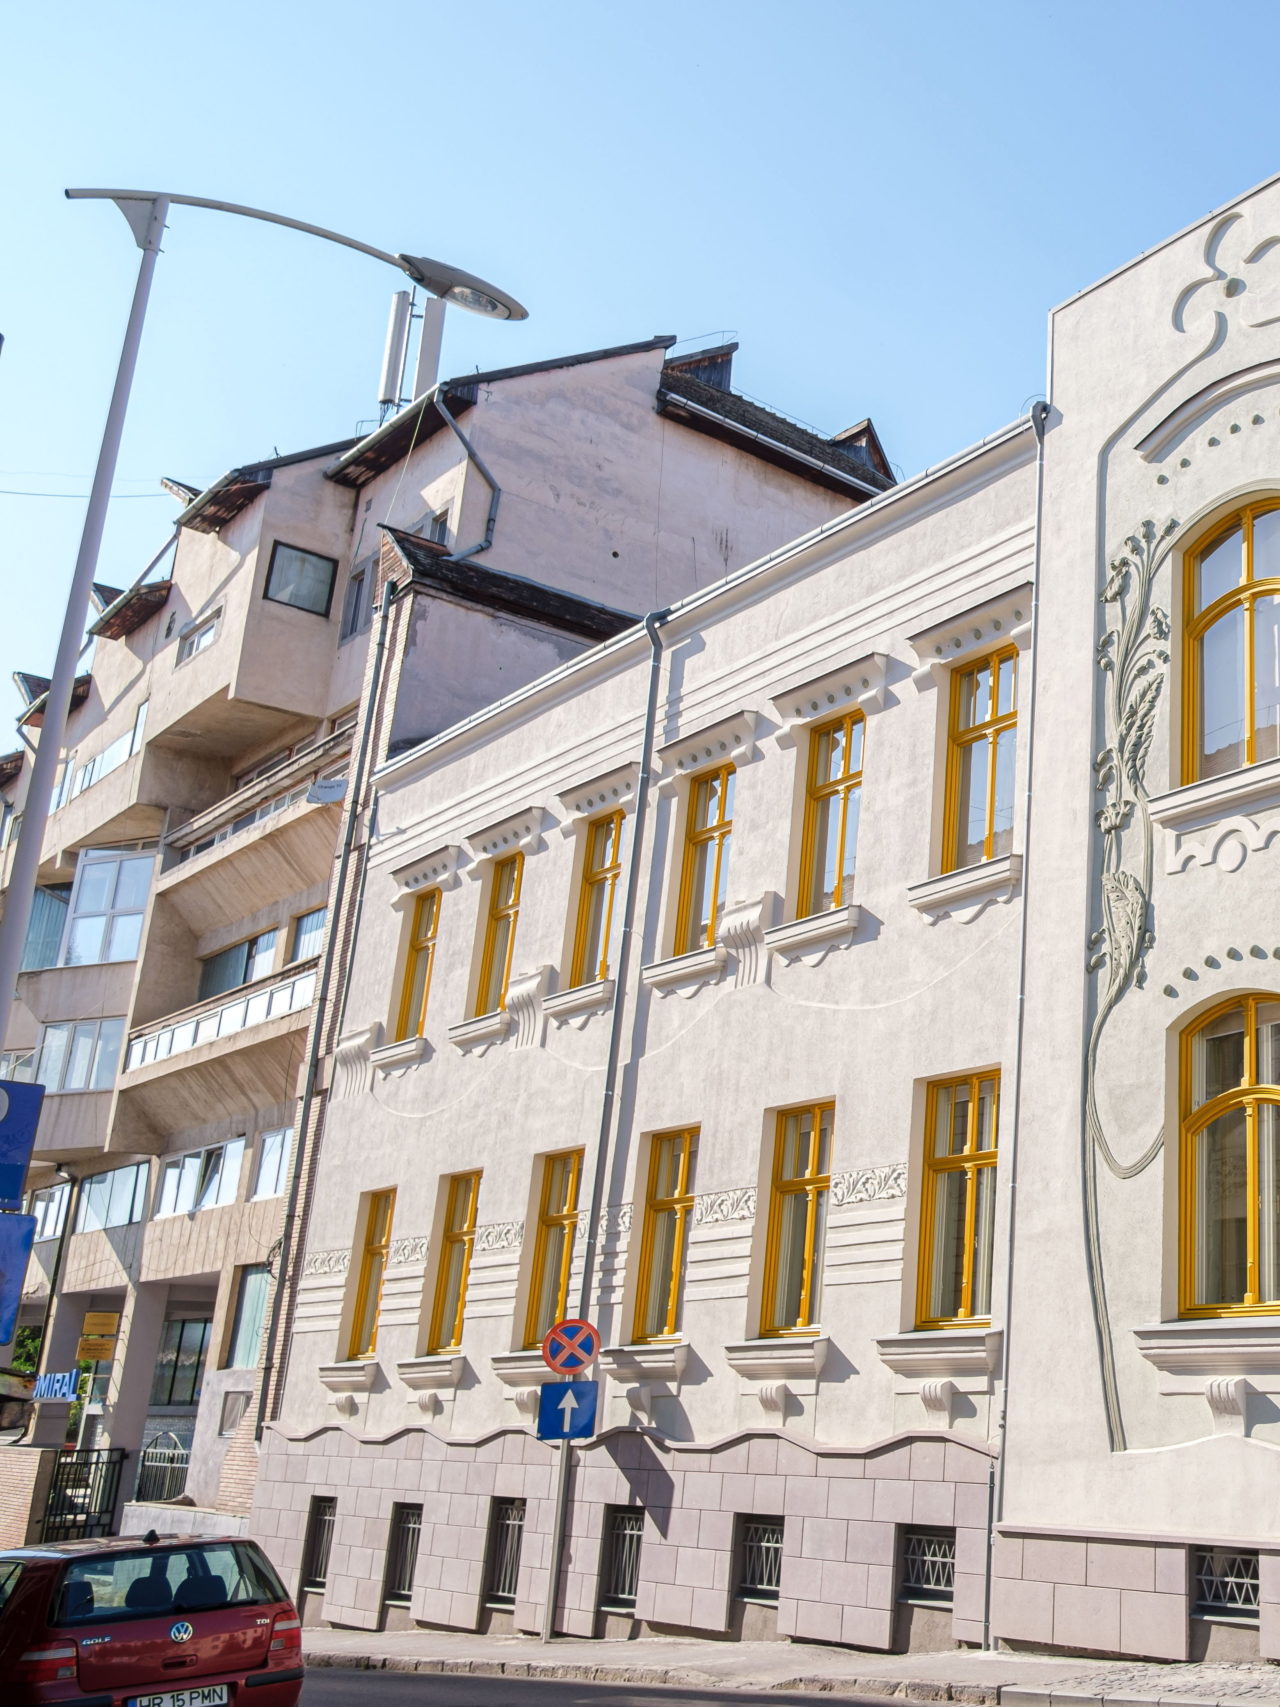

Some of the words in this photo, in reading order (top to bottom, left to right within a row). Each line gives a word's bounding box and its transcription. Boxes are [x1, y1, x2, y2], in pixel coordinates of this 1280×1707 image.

[82, 1636, 111, 1645] GOLF
[139, 1697, 164, 1707] HR
[170, 1693, 186, 1707] 15
[189, 1687, 224, 1706] PMN
